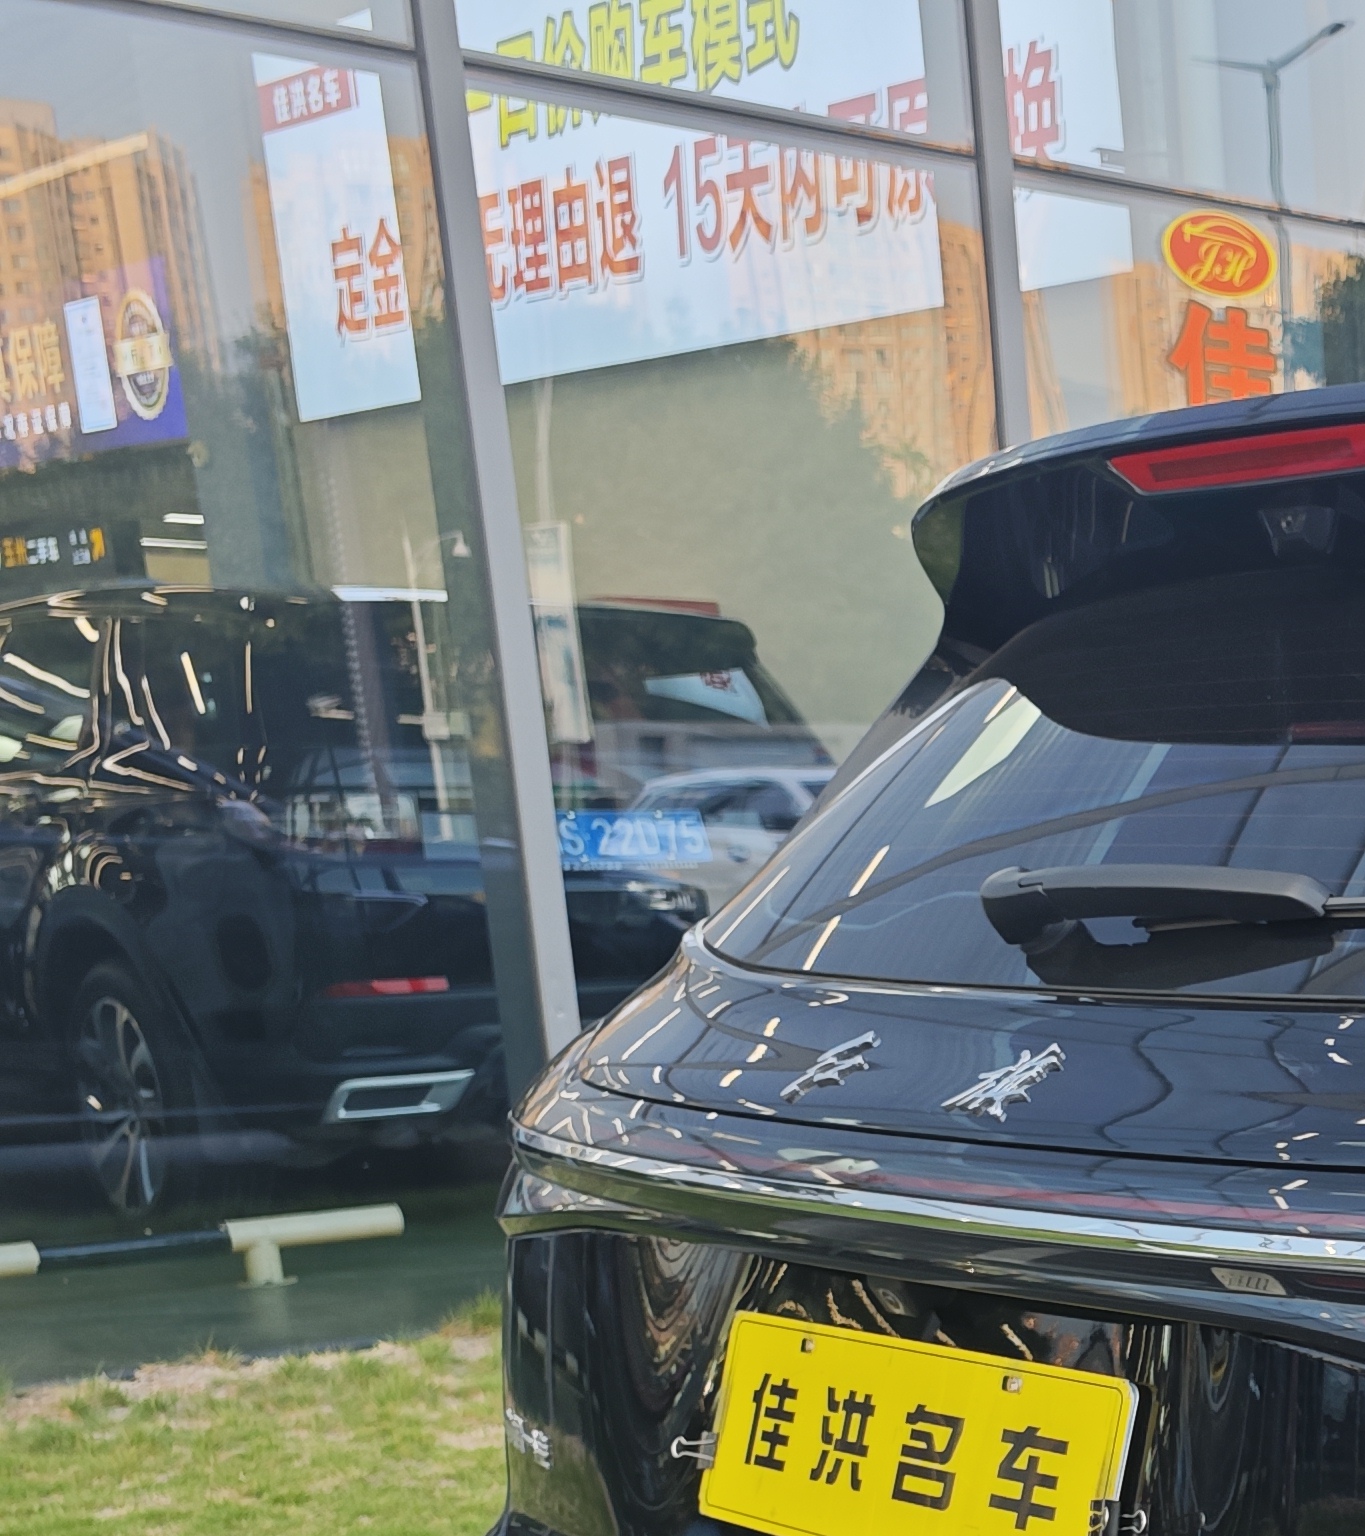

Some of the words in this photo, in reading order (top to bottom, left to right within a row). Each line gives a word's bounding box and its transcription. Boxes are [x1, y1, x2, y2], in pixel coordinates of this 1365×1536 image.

[0, 318, 65, 402] 保障
[744, 1373, 1070, 1531] 佳洪名车
